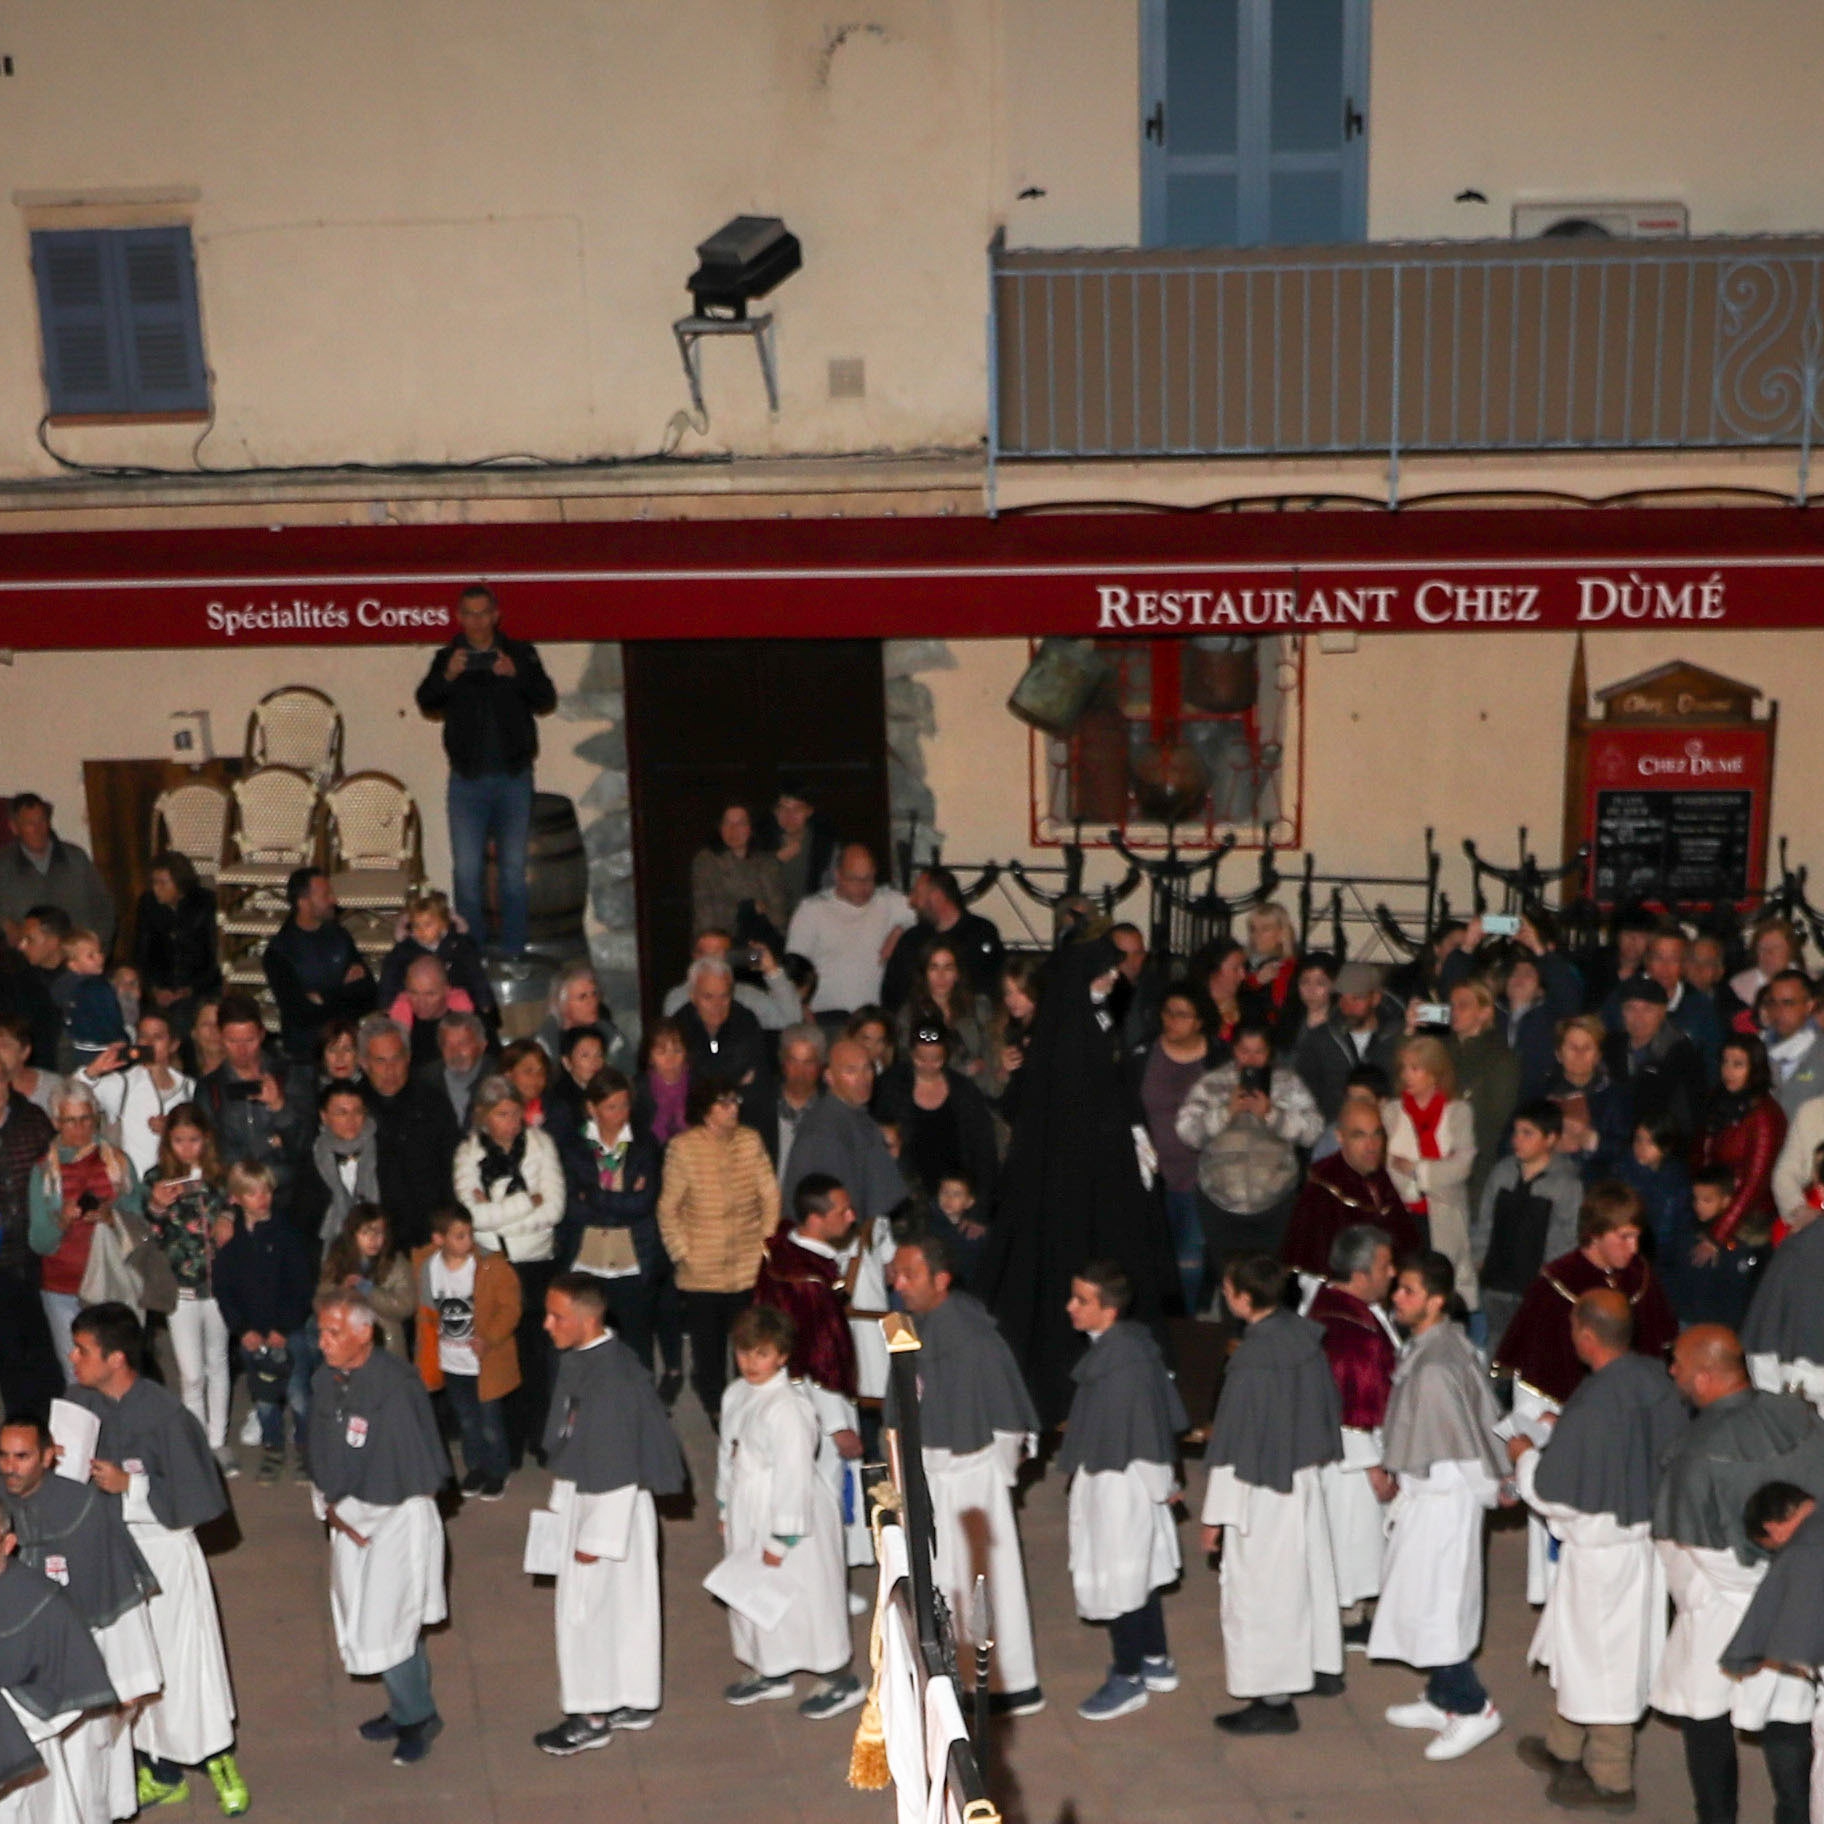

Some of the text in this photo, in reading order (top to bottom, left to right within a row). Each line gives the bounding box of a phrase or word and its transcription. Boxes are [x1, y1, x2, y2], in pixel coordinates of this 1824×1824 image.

[206, 598, 451, 637] Spécialités Corses
[1096, 571, 1727, 628] RESTAURANT CHEZ DÙMÉ
